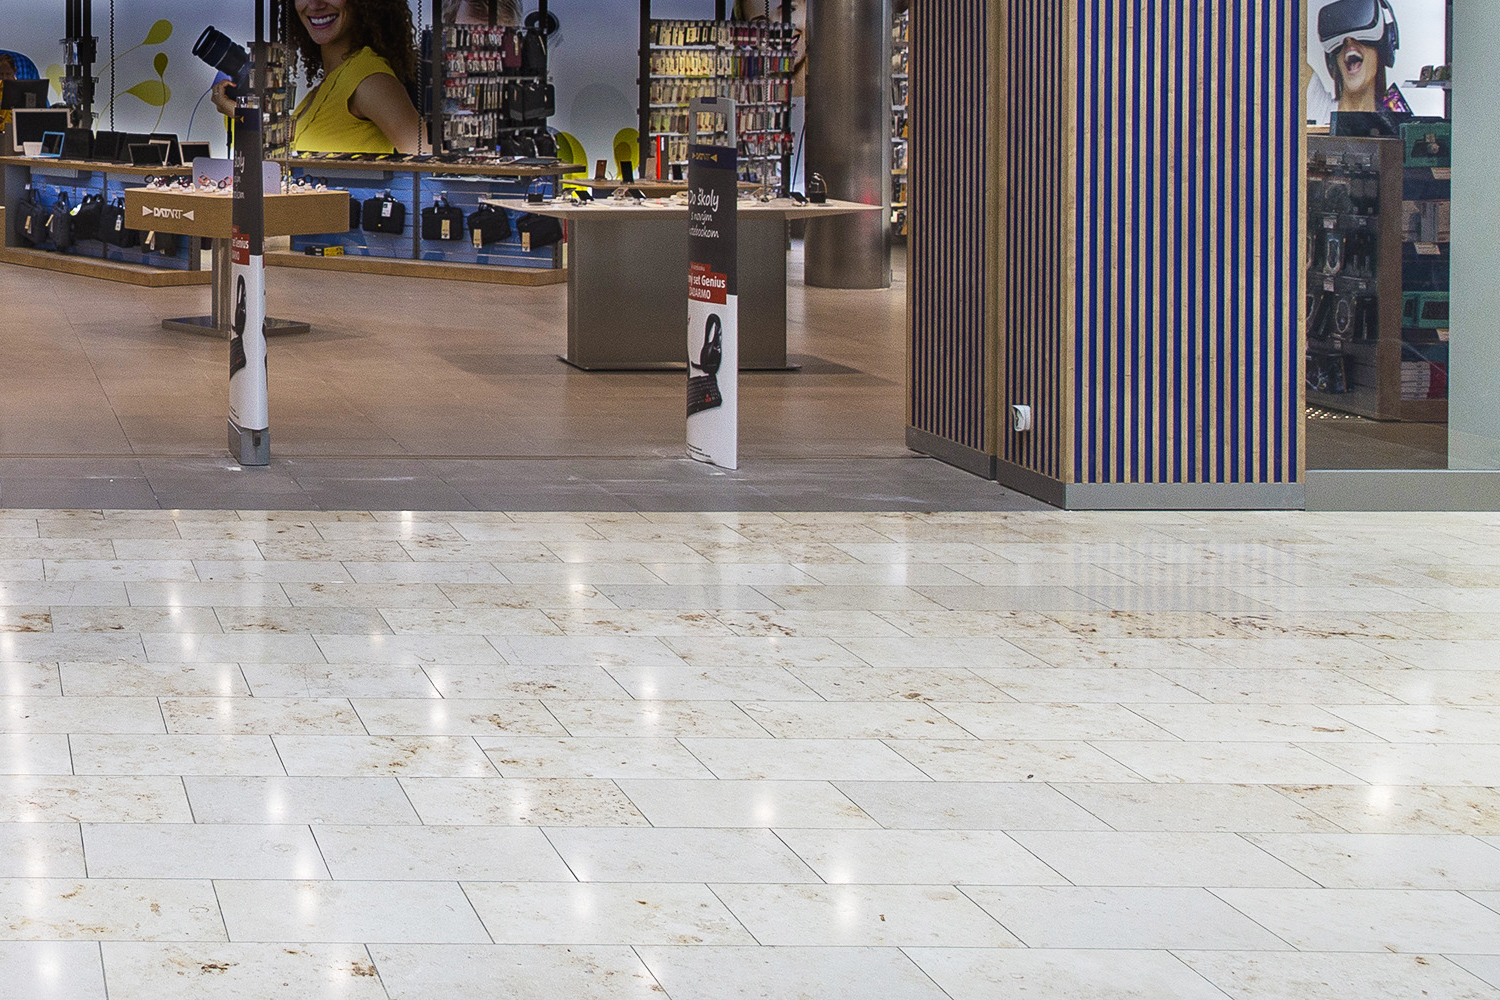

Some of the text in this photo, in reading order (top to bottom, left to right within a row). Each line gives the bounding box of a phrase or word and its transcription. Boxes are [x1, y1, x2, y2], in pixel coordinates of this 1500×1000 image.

[697, 187, 719, 212] školy
[153, 207, 183, 220] DATART
[701, 275, 726, 289] Genius
